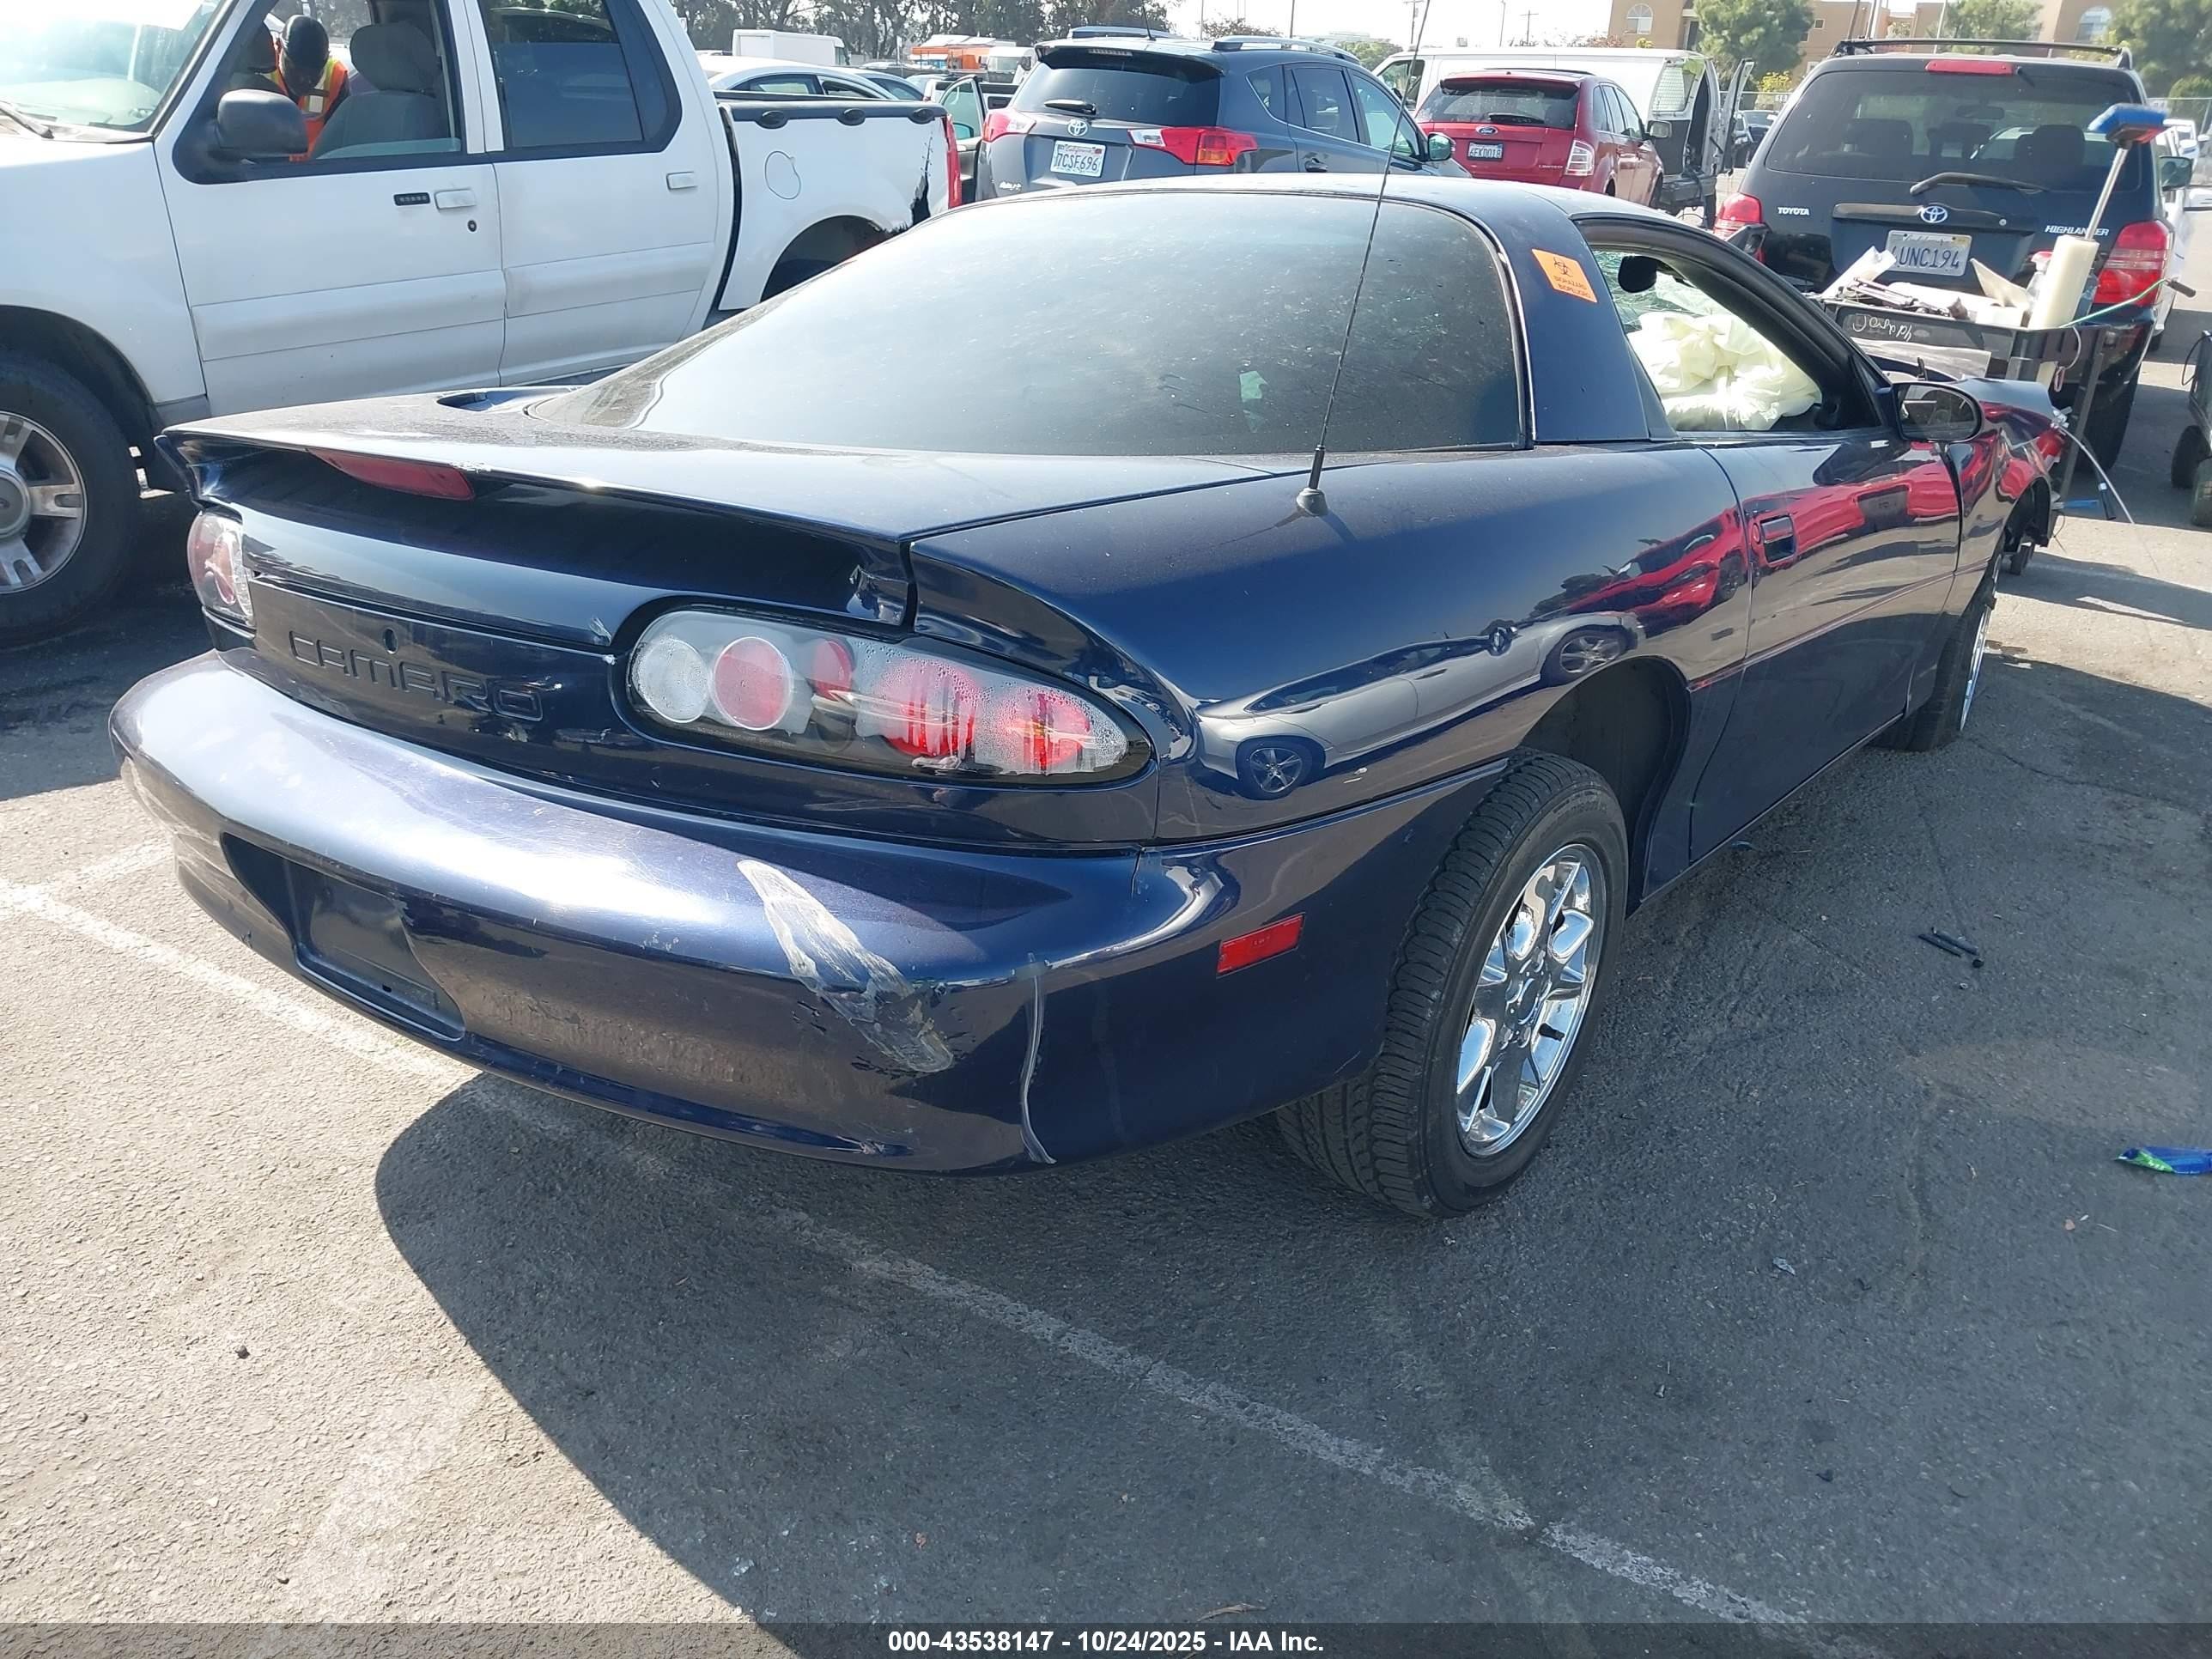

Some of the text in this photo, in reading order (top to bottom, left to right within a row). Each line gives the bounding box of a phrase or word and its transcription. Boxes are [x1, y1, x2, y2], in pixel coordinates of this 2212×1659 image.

[1778, 207, 1809, 216] TOYOTA
[2045, 225, 2110, 236] HIGHLANER
[289, 630, 544, 721] CAMARO
